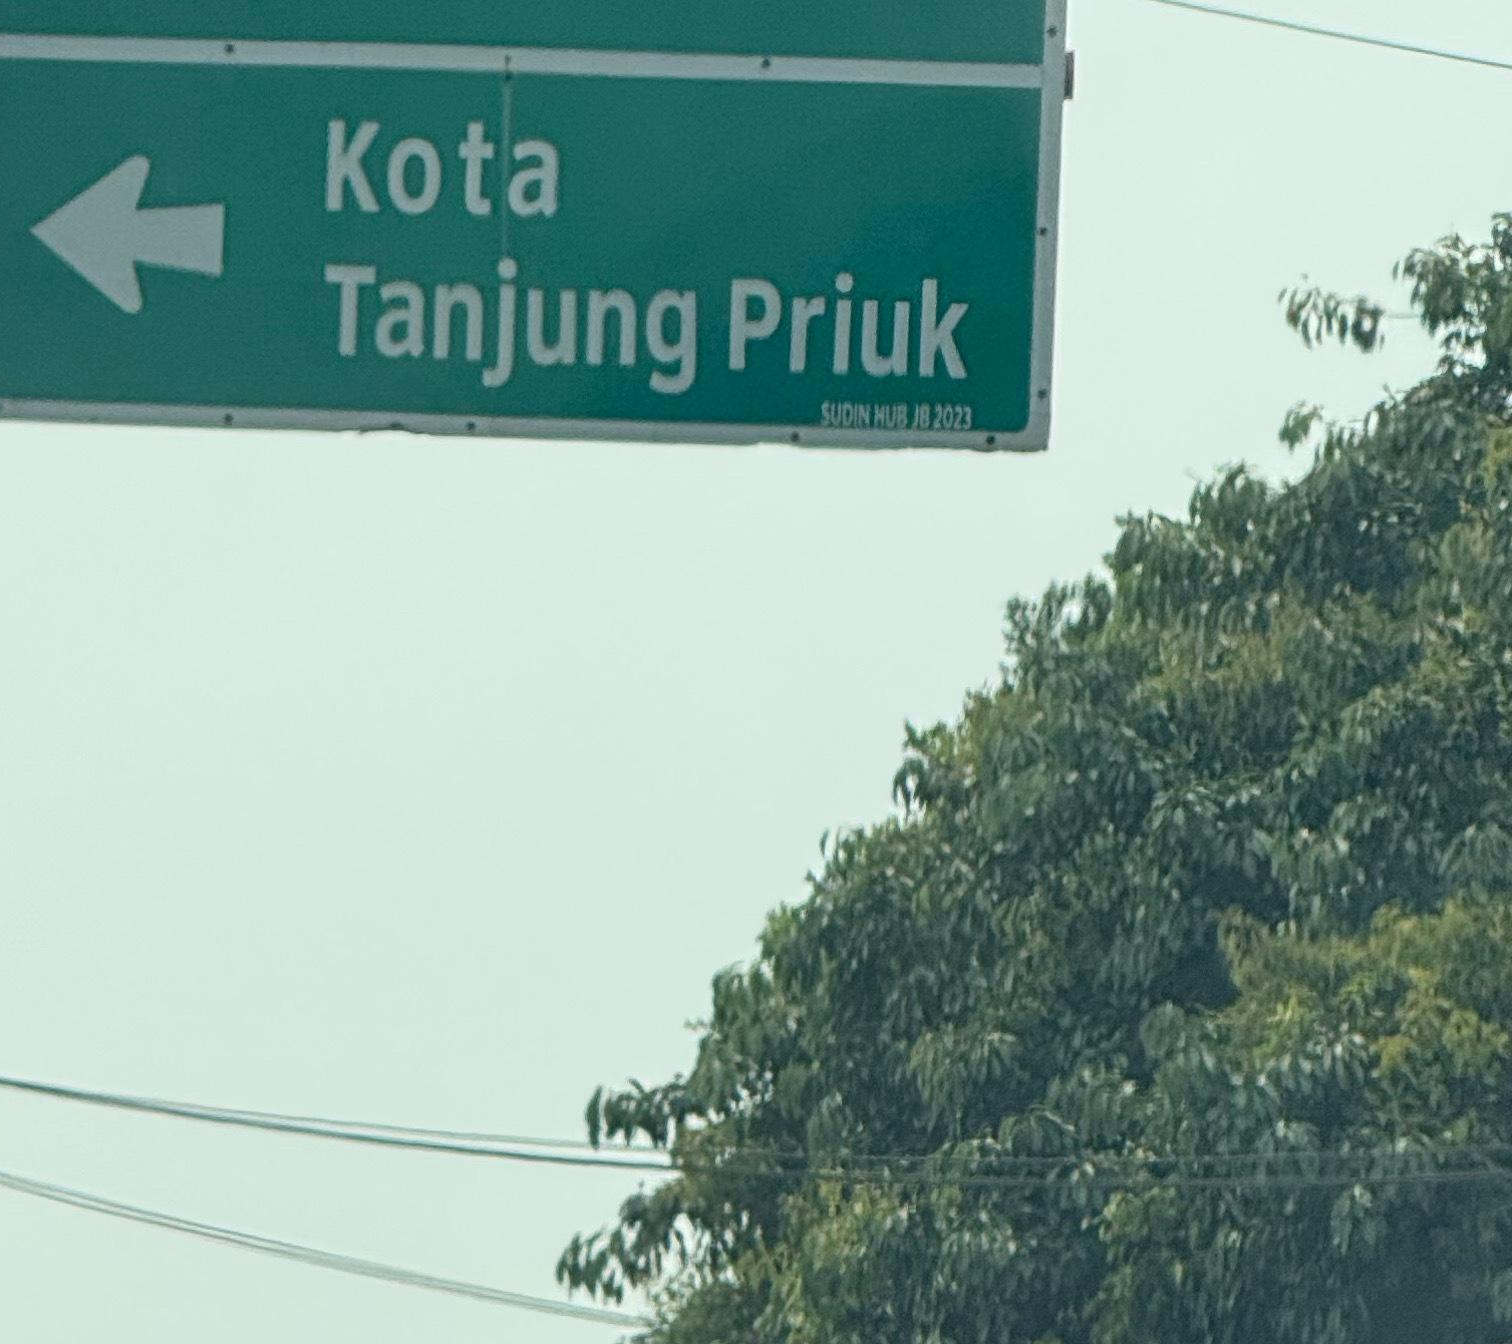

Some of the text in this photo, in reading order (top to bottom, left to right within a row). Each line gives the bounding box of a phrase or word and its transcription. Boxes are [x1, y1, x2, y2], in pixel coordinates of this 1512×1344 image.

[324, 119, 560, 217] Kota
[325, 259, 970, 394] Tanjung Priuk
[821, 400, 870, 427] SUDIN
[874, 402, 908, 430] HUB
[934, 404, 973, 430] 2023
